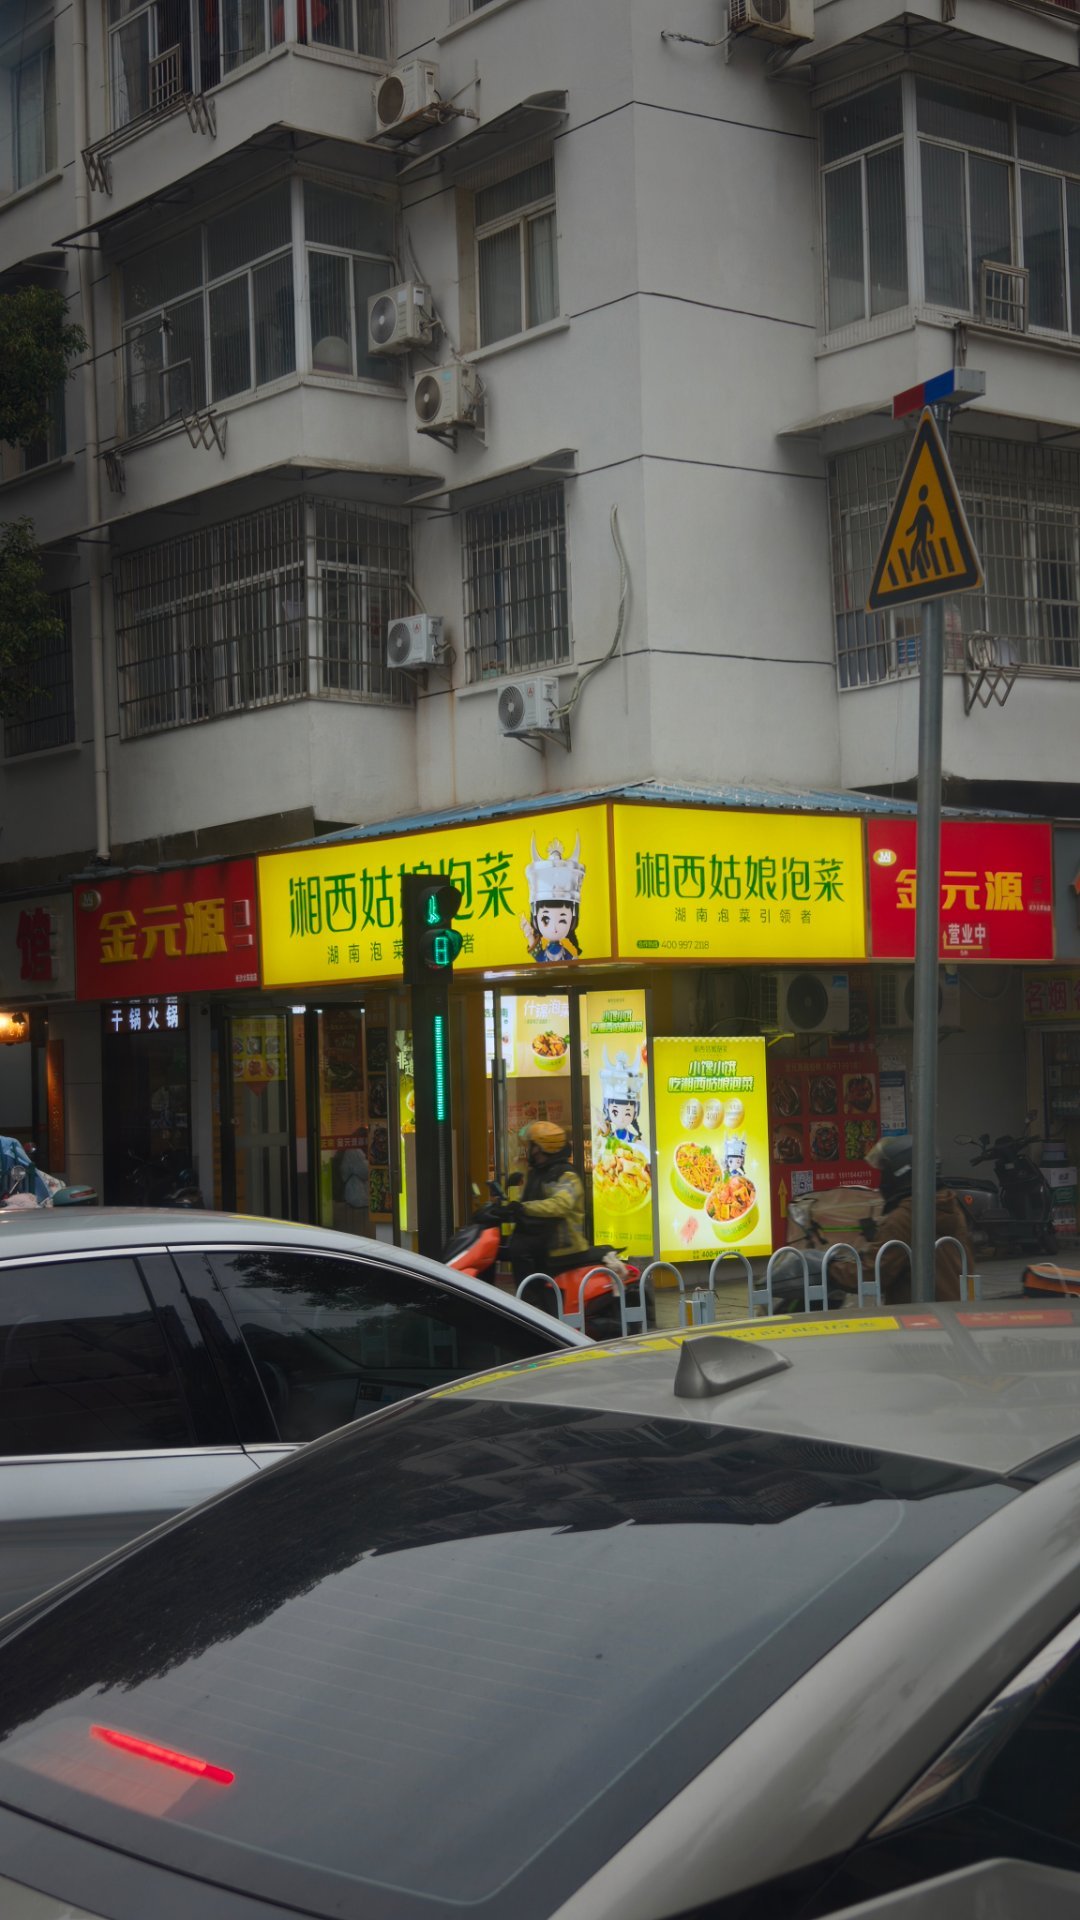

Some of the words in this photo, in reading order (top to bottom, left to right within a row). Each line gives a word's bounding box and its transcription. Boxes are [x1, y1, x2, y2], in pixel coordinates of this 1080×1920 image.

[635, 851, 845, 902] 湘西姑娘泡菜
[288, 851, 516, 938] 湘西姑泡菜
[674, 907, 812, 924] 湖南泡菜引领者
[99, 898, 228, 964] 金元源
[661, 940, 677, 949] 400
[678, 940, 693, 950] 997
[948, 923, 986, 945] 营业中
[326, 932, 475, 965] 湖南泡菜者
[111, 1004, 179, 1032] 干锅火锅
